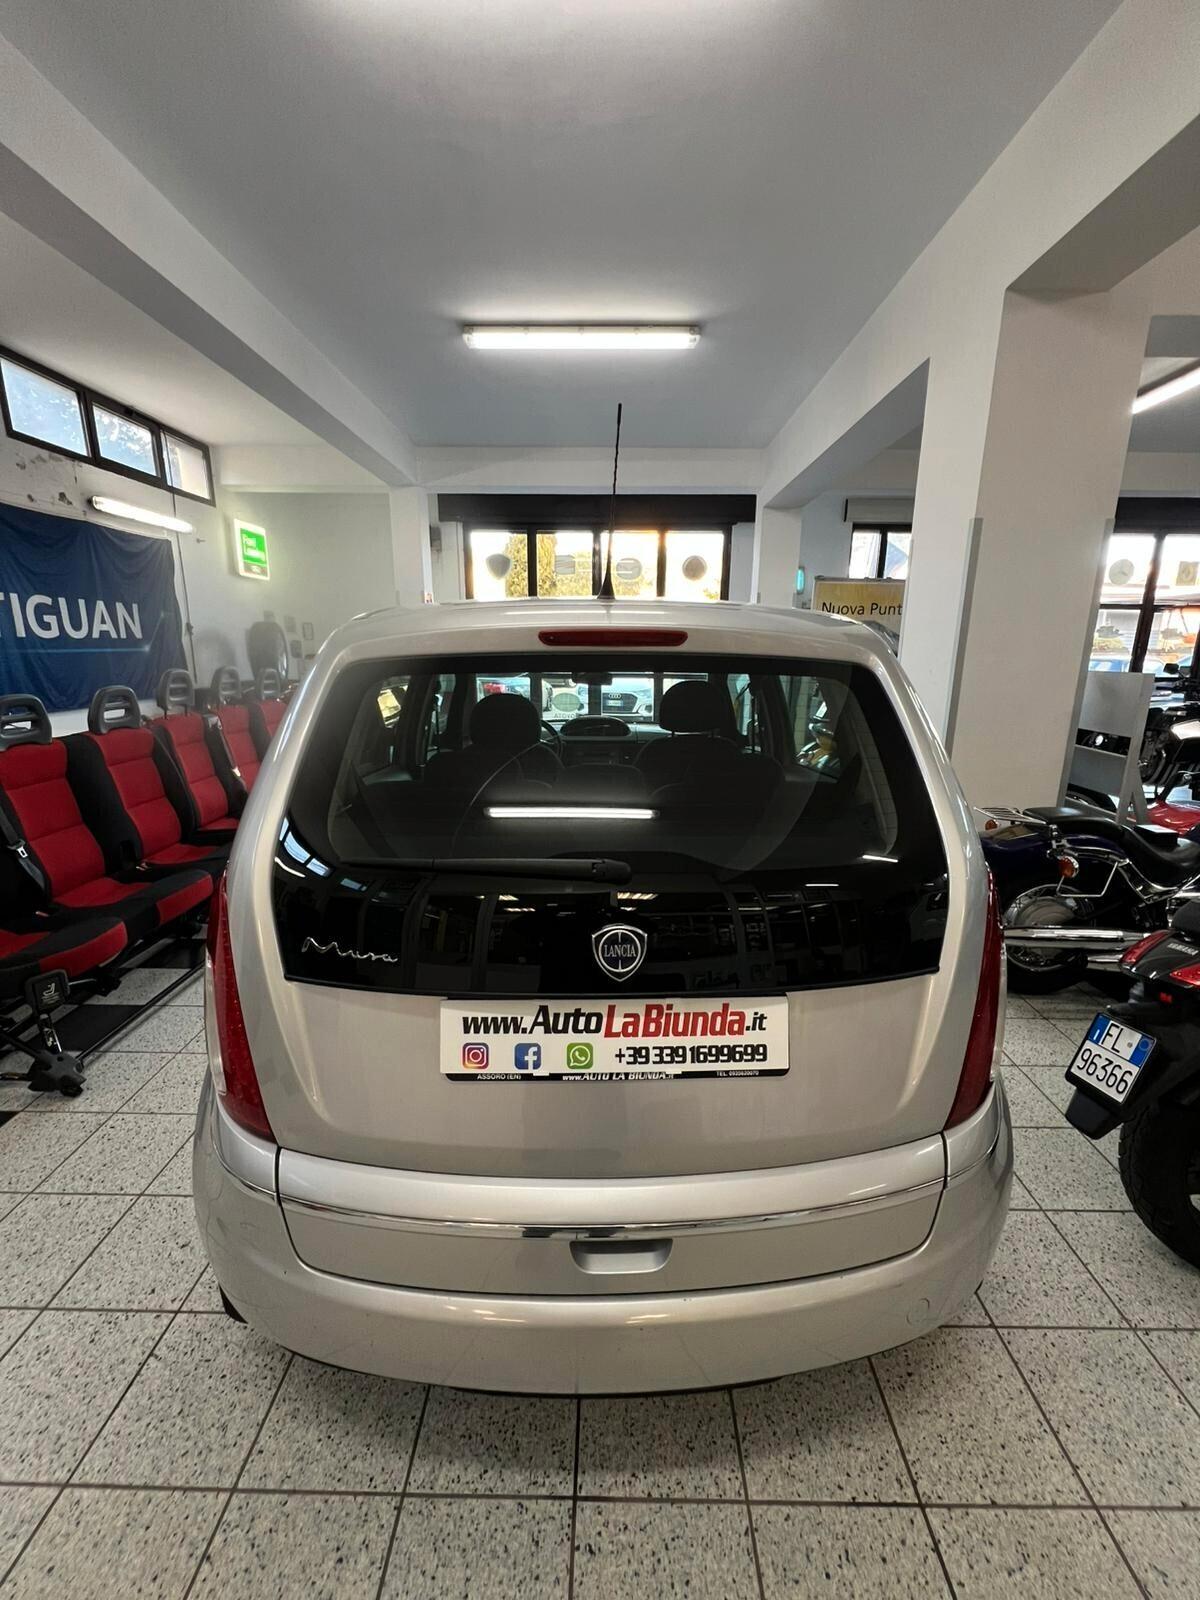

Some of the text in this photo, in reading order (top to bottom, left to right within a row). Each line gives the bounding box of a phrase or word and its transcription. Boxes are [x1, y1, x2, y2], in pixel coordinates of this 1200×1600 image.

[0, 592, 143, 640] IGUAN
[821, 602, 865, 616] Nuova
[301, 936, 398, 962] Musa
[604, 944, 636, 957] LANCIA
[462, 1003, 768, 1038] www.AutoLaBiunda.it
[1101, 1022, 1124, 1053] FL
[1076, 1048, 1133, 1095] 96366
